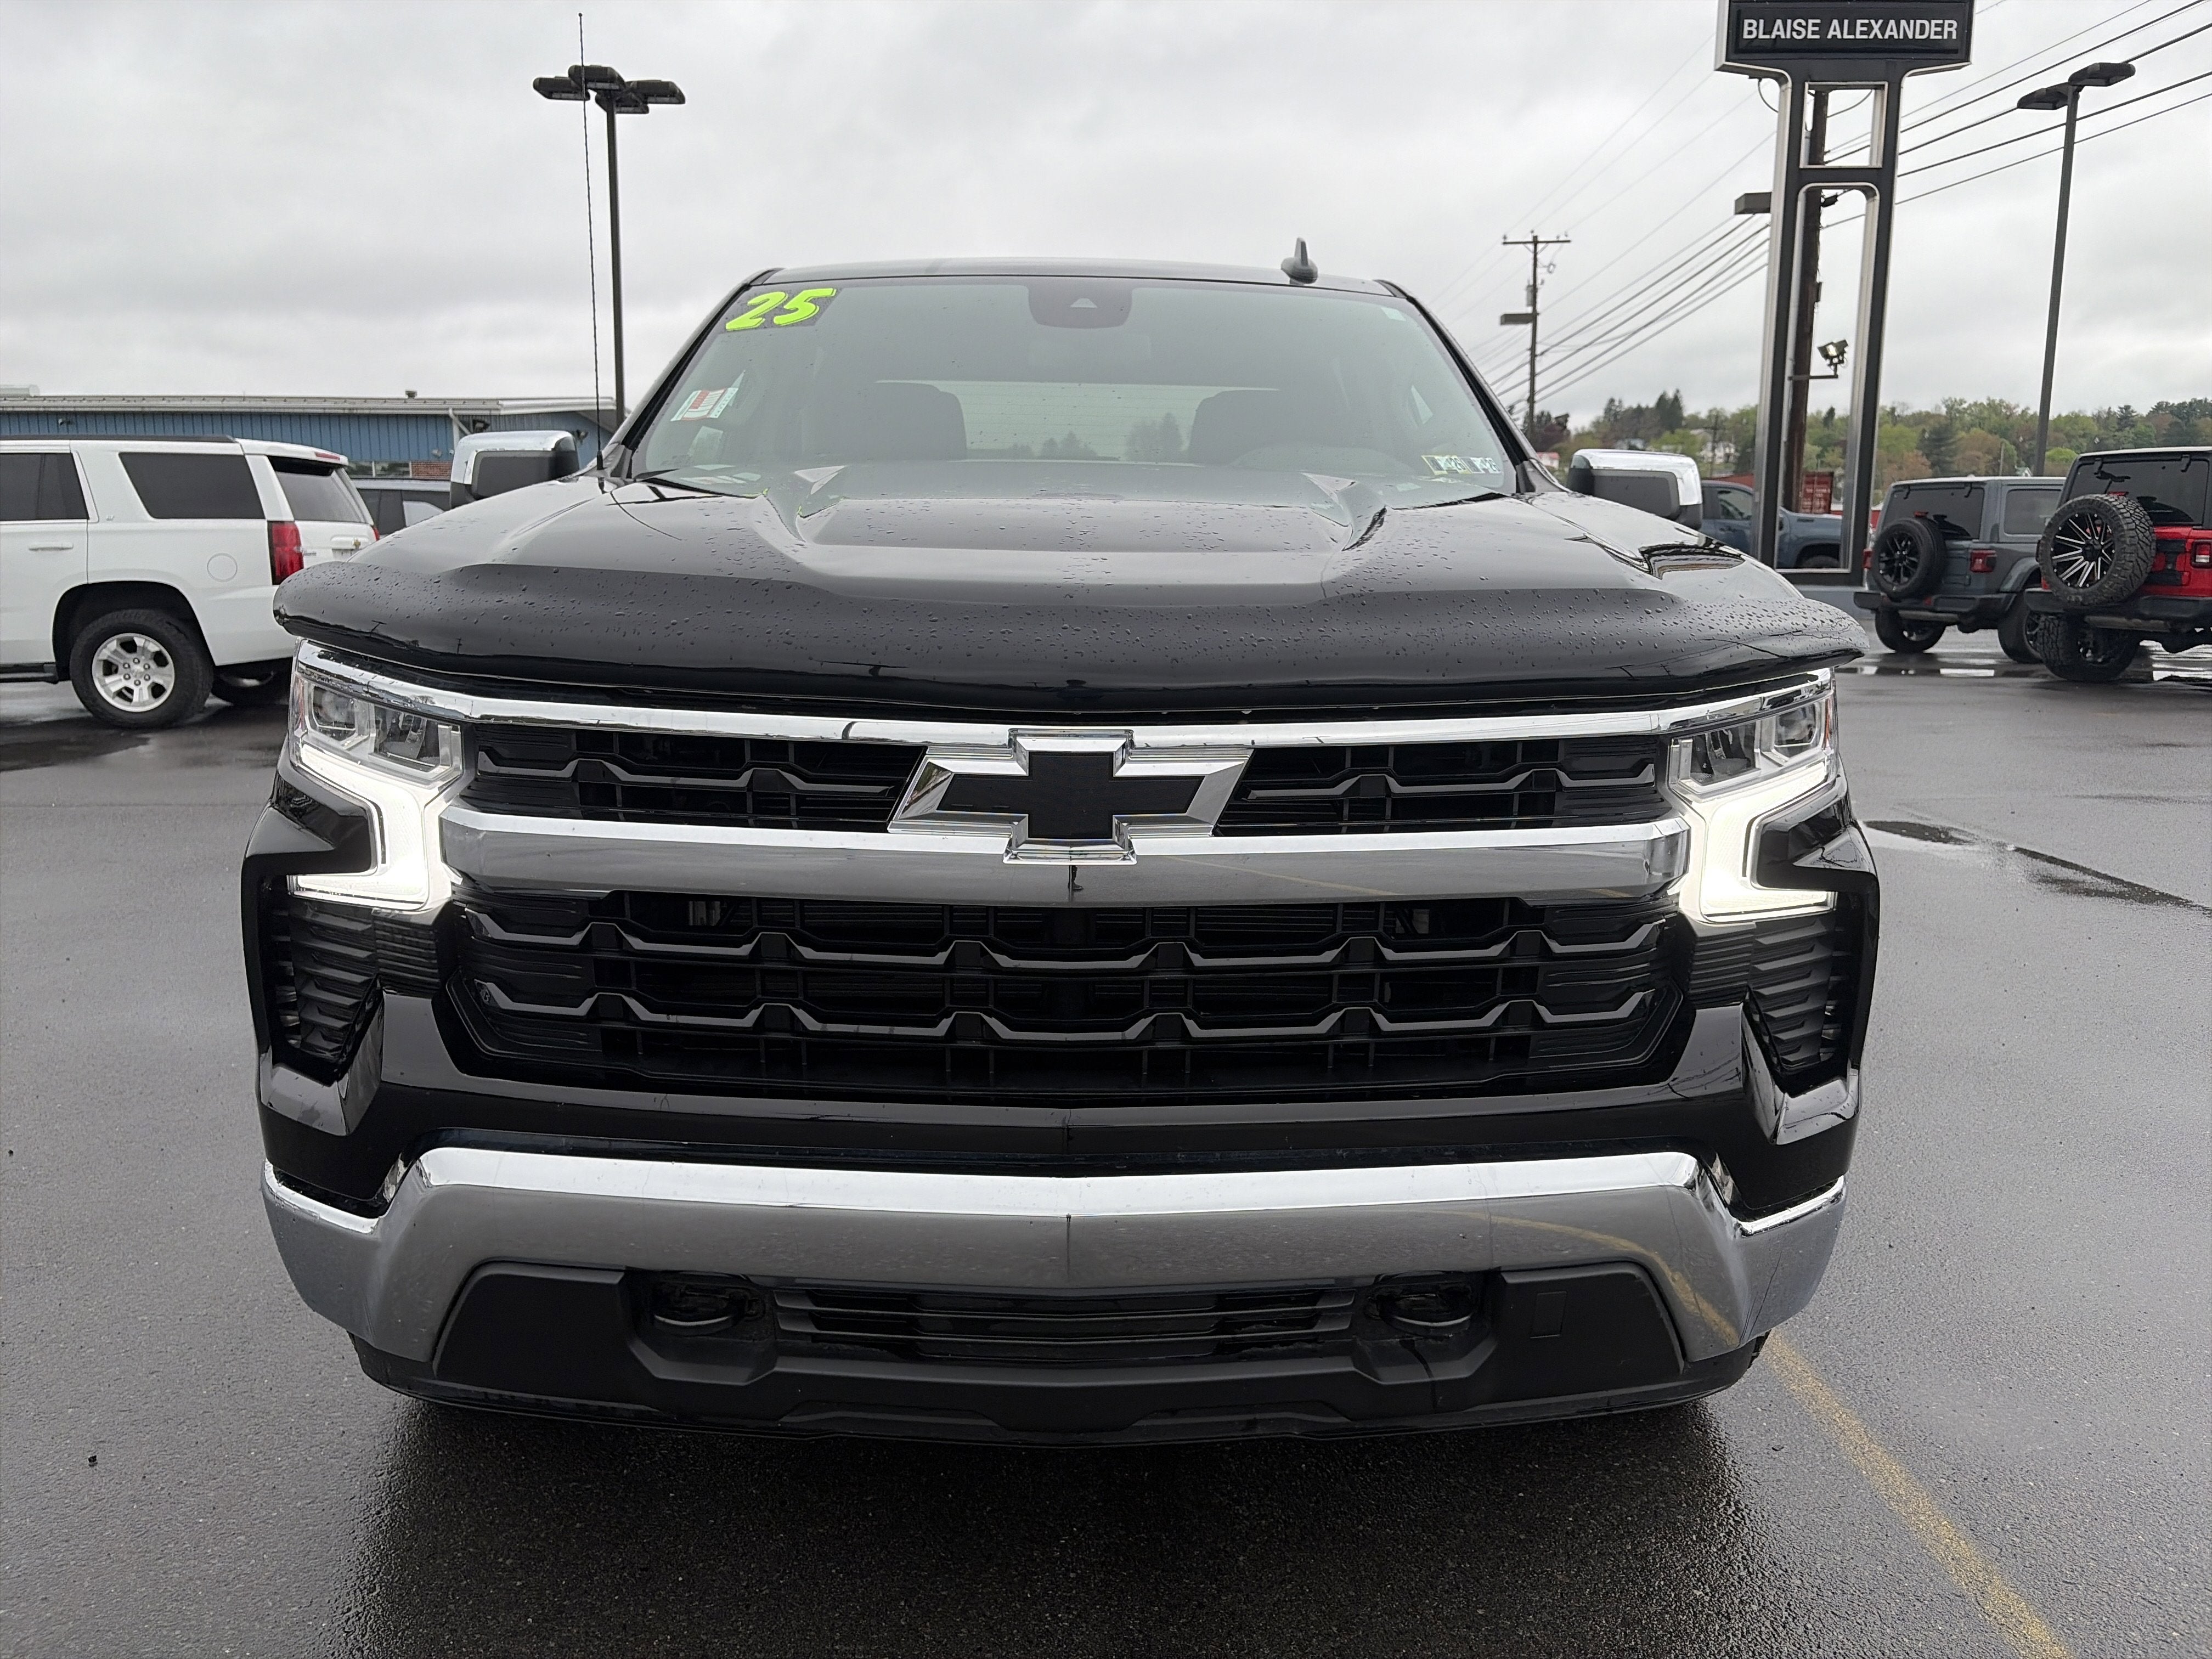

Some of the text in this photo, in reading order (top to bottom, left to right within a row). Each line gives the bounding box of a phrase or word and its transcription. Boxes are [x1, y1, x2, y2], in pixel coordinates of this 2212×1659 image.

[1742, 19, 1958, 40] BLAISE ALEXANDER
[726, 288, 837, 331] 25
